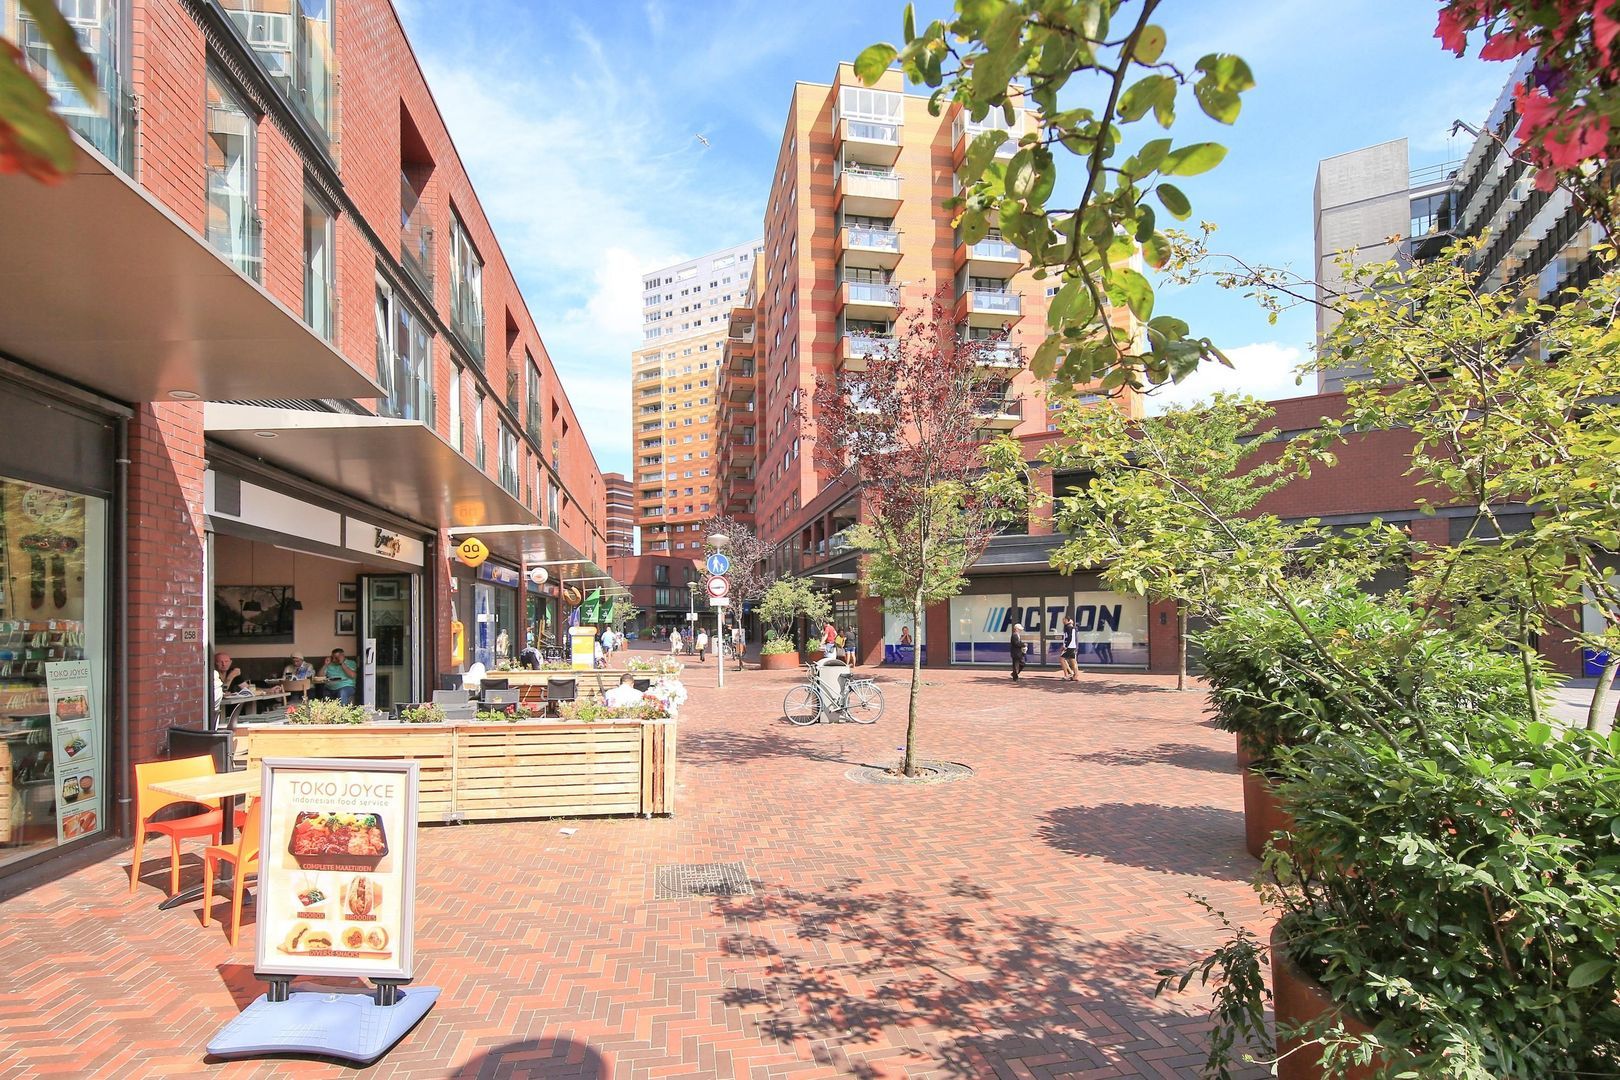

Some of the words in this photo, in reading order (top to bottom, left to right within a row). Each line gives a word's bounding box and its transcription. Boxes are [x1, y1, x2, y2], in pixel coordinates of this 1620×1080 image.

[1001, 604, 1122, 633] ACTON
[184, 630, 196, 640] 258
[49, 669, 69, 678] TOKO
[290, 781, 337, 796] TOKO
[341, 783, 394, 798] JOYCE
[338, 798, 357, 806] food
[359, 799, 389, 807] service
[303, 863, 335, 871] COMPLETE
